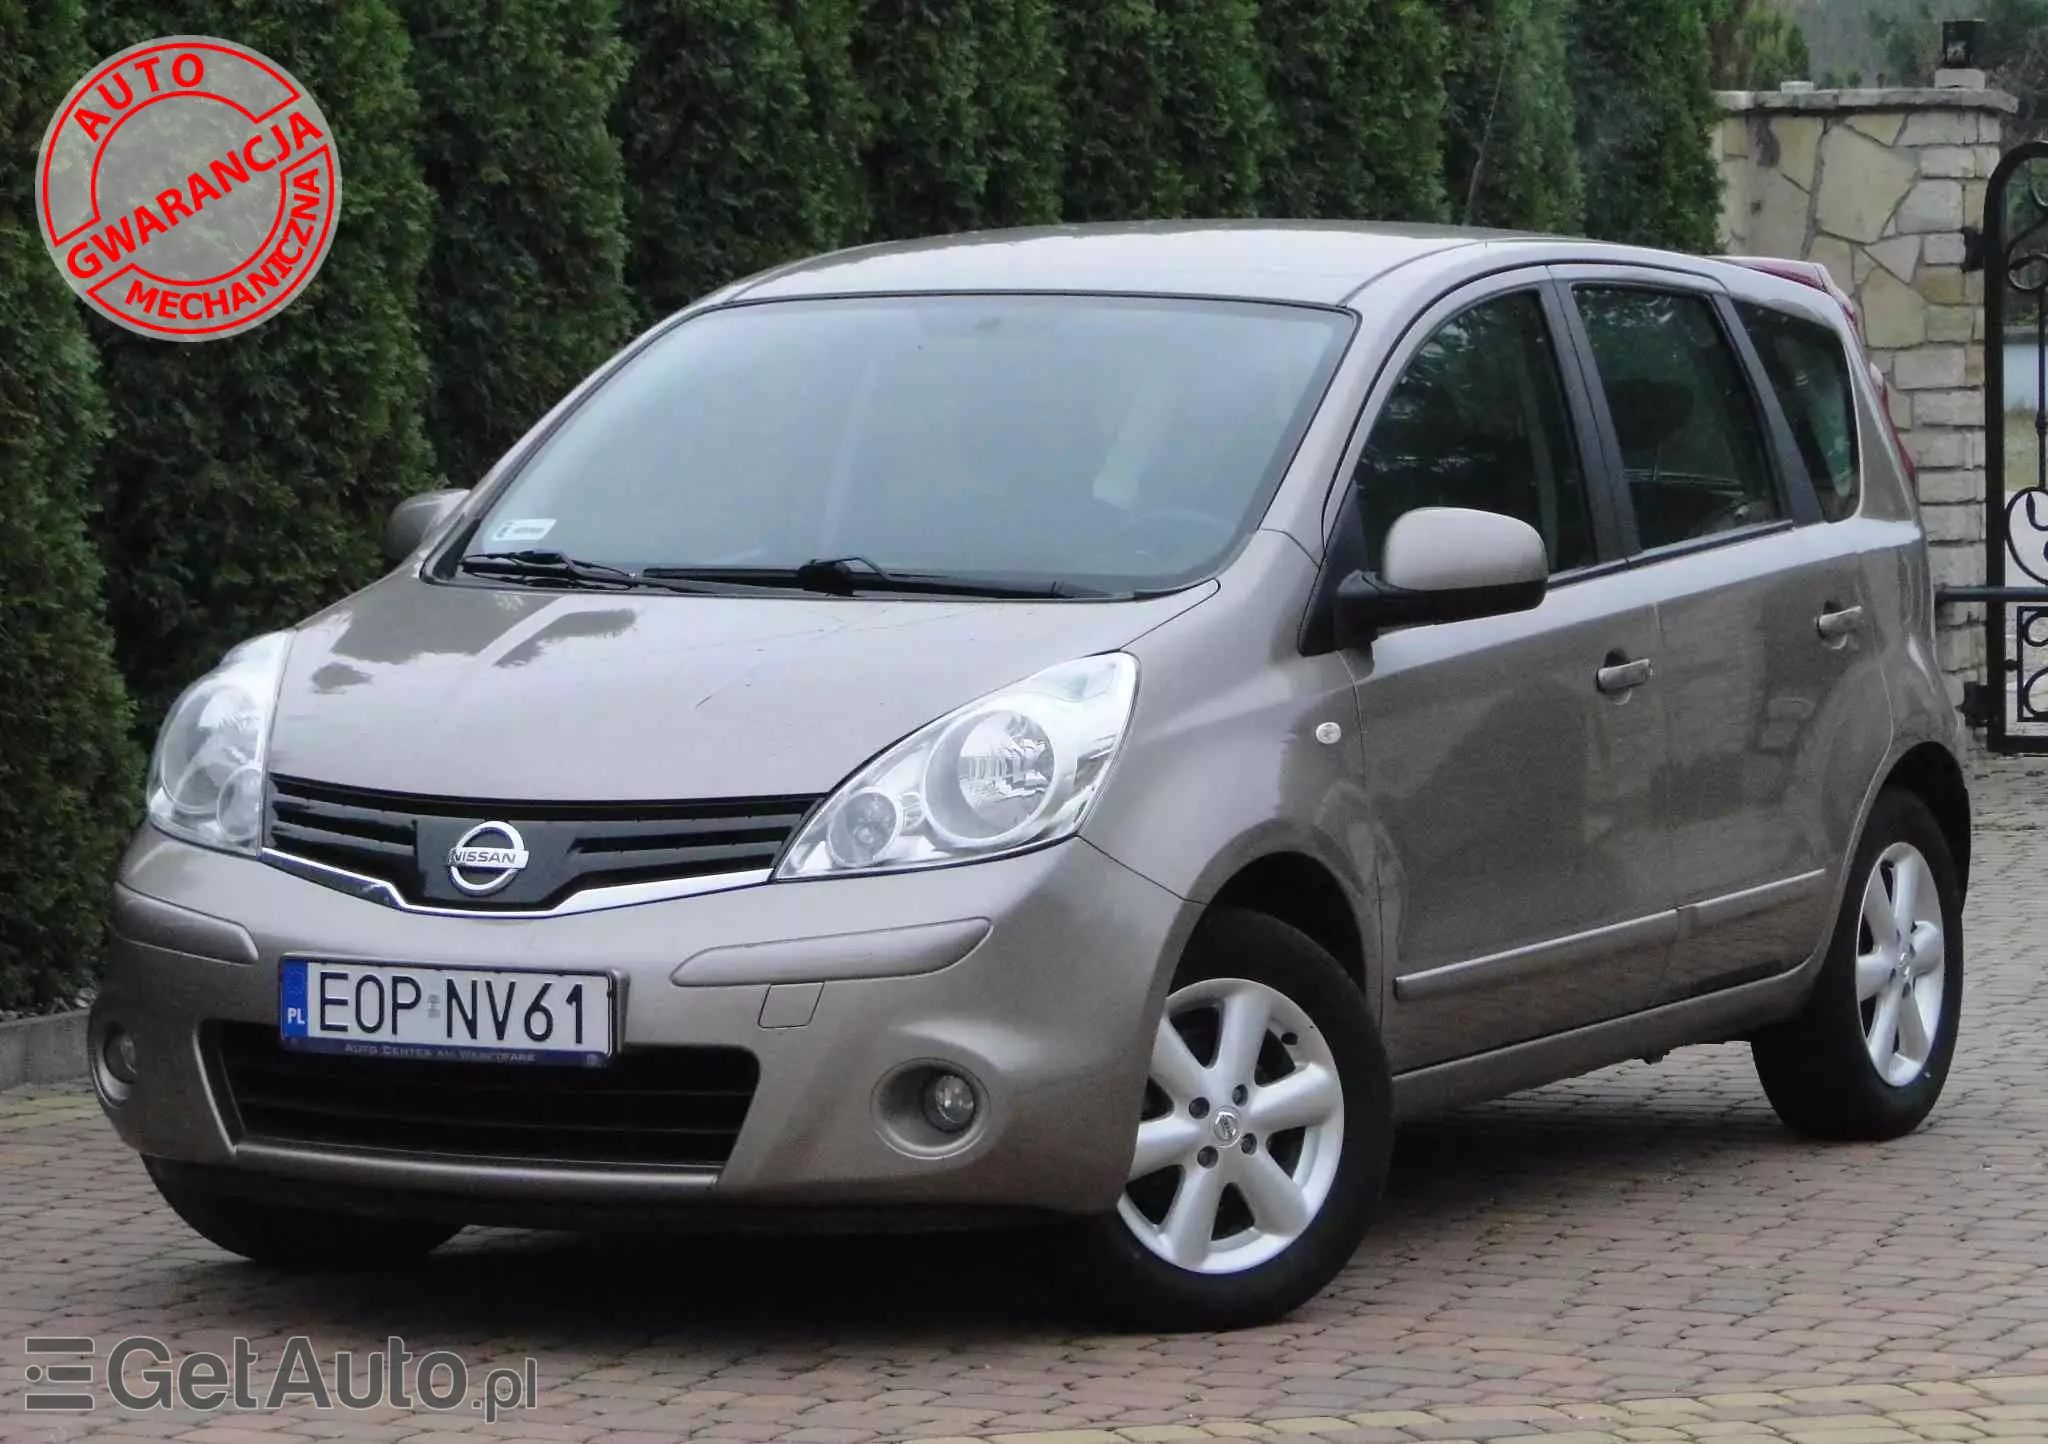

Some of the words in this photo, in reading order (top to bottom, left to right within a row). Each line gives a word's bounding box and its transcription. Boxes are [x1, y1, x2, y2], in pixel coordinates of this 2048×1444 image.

[452, 850, 517, 865] NISSAN
[287, 1007, 306, 1025] PL
[319, 971, 422, 1036] EOP
[446, 978, 583, 1045] NV61
